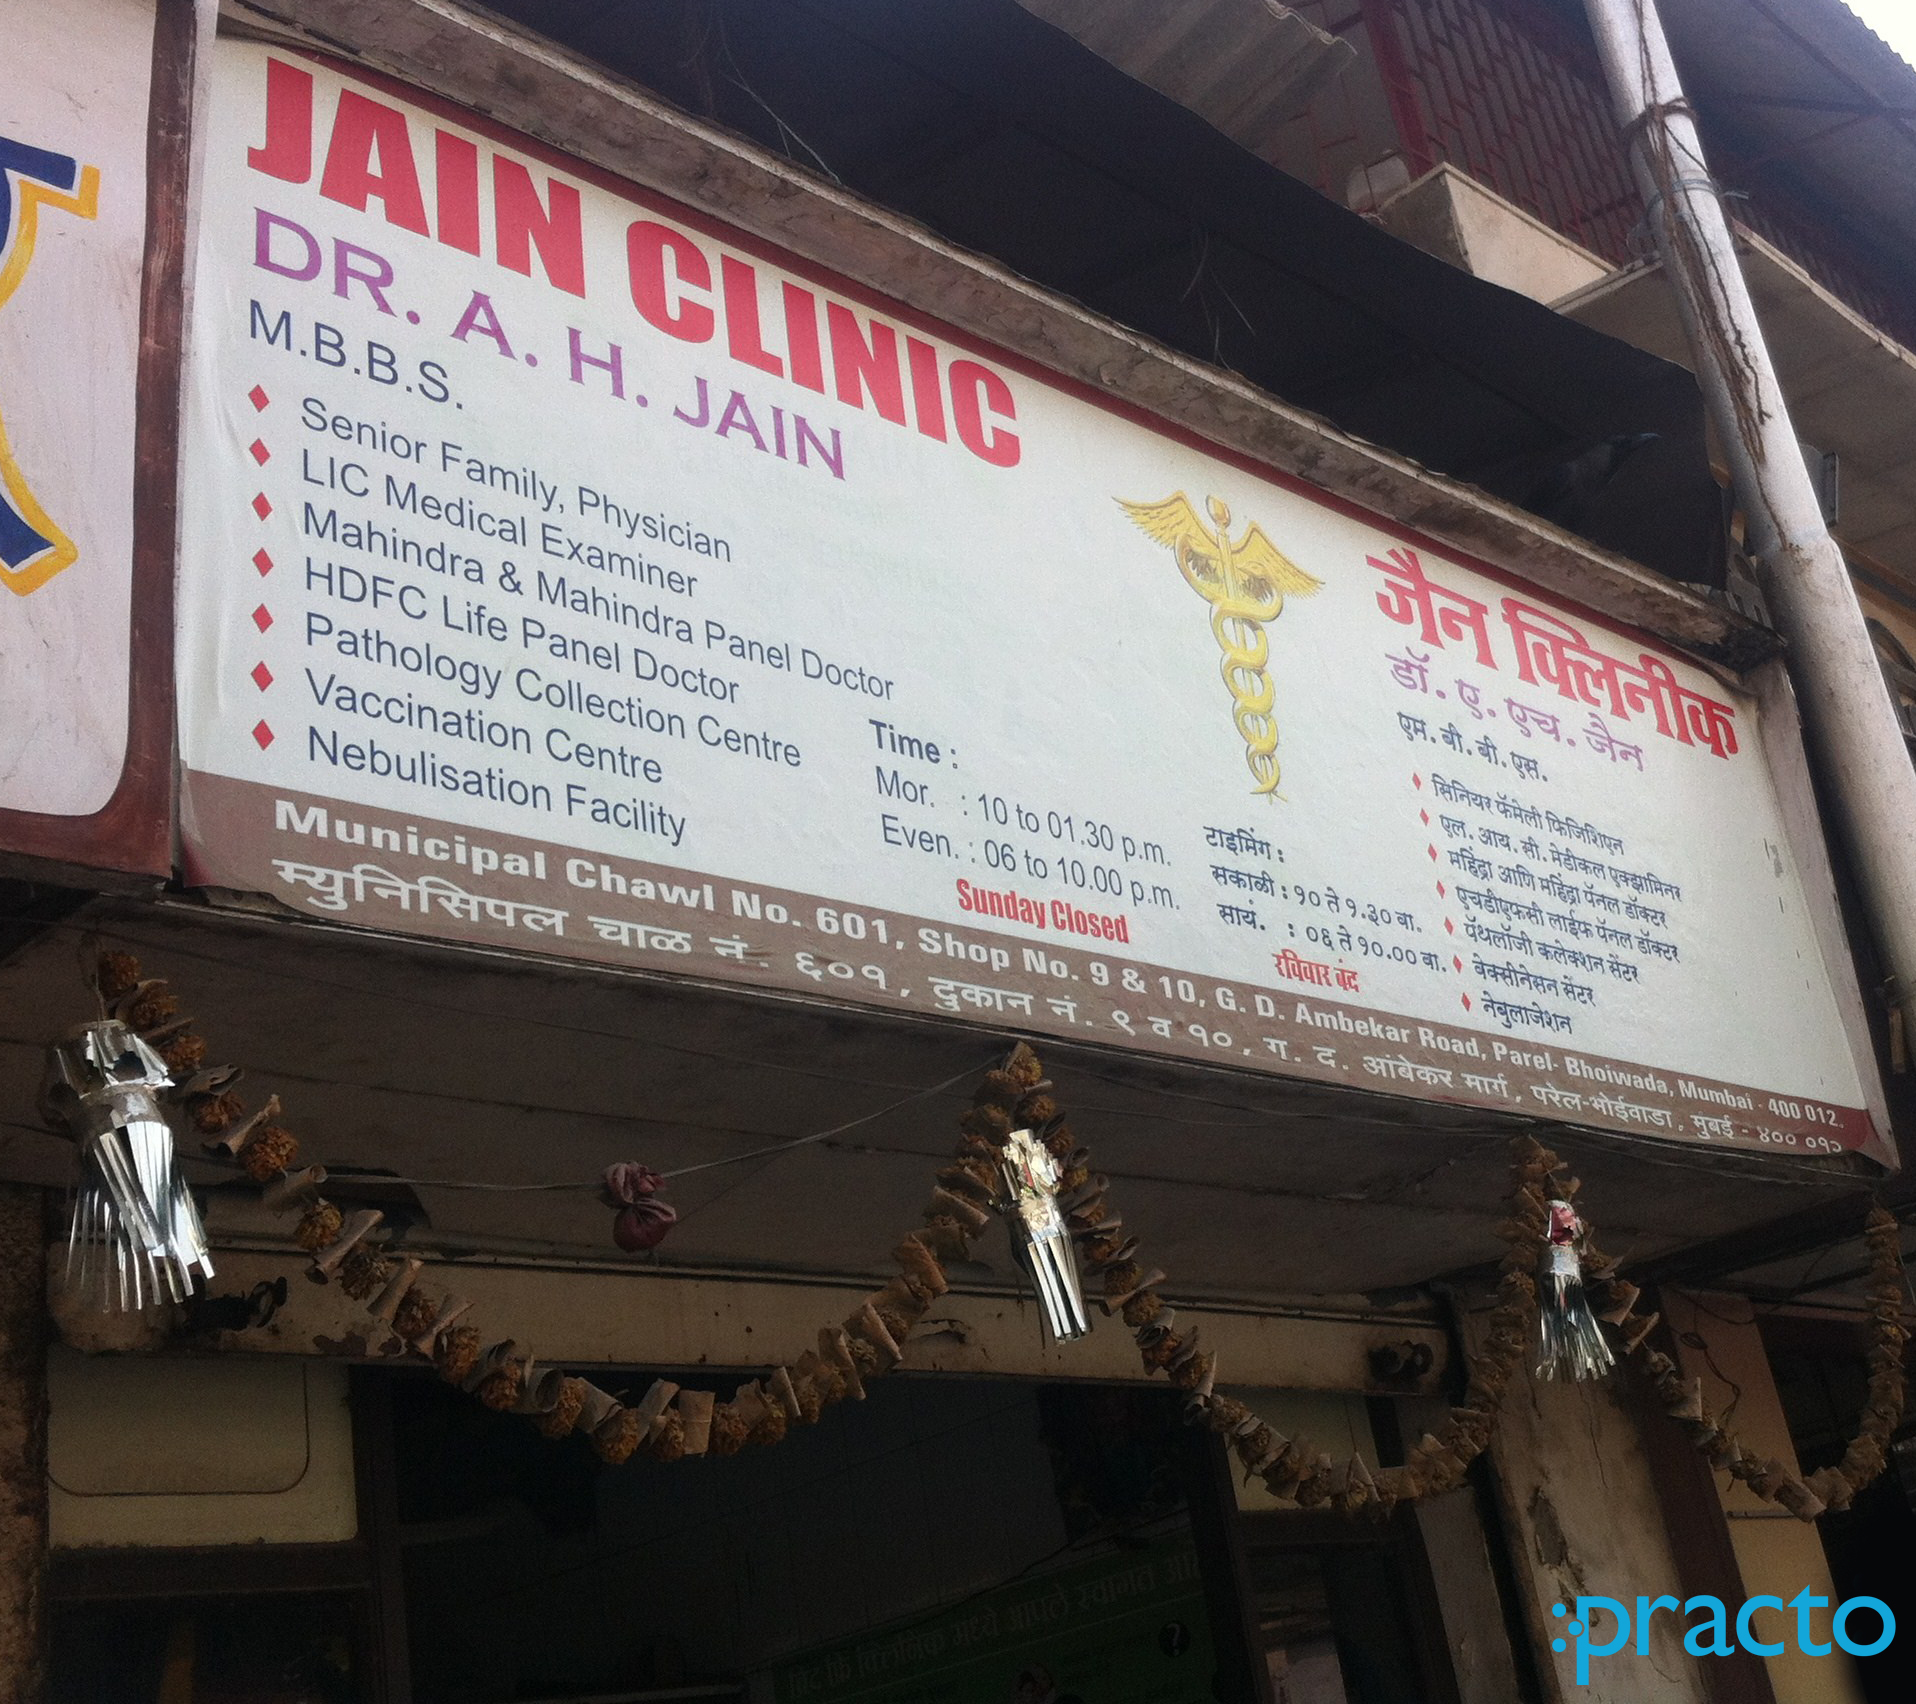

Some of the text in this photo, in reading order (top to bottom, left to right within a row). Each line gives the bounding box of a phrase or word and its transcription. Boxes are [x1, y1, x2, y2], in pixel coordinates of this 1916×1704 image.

[247, 56, 1020, 468] JAIN CLINIC
[249, 298, 462, 410] M.B.B.S.
[253, 206, 846, 481] DR. A. H. JAIN
[301, 397, 731, 563] Senior Family, Physician
[303, 448, 697, 597] LIC Medical Examiner
[304, 501, 894, 700] Mahindra & Mahindra Panel Doctor
[305, 556, 740, 704] HDFC Life Panel Doctor
[1366, 547, 1738, 760] जैन क्लिनीक
[304, 667, 662, 784] Vaccination Centre
[306, 611, 801, 767] Pathology Collection Centre
[868, 718, 941, 764] Time
[1582, 712, 1644, 772] जैन
[309, 725, 686, 847] Nebulisation Facility
[875, 765, 935, 808] Mor.
[978, 793, 1008, 826] 10
[1016, 803, 1040, 834] to
[1047, 811, 1114, 852] 01.30
[1121, 835, 1171, 867] p.m.
[1431, 773, 1494, 815] सिनियर
[881, 813, 959, 859] Even.
[984, 839, 1017, 872] 06
[1024, 849, 1048, 880] to
[1057, 857, 1123, 897] 10.00
[1129, 880, 1180, 910] p.m.
[956, 878, 1130, 944] Sunday Closed
[1209, 864, 1275, 897] सकाळी
[1293, 885, 1321, 907] १०
[1324, 887, 1340, 914] ते
[1497, 863, 1536, 892] आणि
[1582, 881, 1621, 915] पॅनल
[1621, 894, 1668, 930] डॉक्टर
[272, 859, 570, 936] म्युनिसिपल
[587, 916, 692, 953] चाळ
[928, 976, 1034, 1015] दुकान
[1363, 1054, 1453, 1088] आंबेकर
[275, 800, 546, 879] Municipal
[566, 858, 714, 911] Chawl
[732, 890, 801, 926] No.
[816, 907, 904, 950] 601,
[918, 928, 1010, 972] Shop
[1022, 948, 1078, 981] No.
[1089, 962, 1109, 986] 9
[1122, 968, 1147, 994] &
[1159, 976, 1205, 1007] 10,
[1215, 987, 1246, 1013] G.
[1255, 994, 1285, 1020] D.
[1296, 1003, 1410, 1043] Ambekar
[1417, 1026, 1486, 1060] Road,
[1564, 1056, 1673, 1097] Bhoiwada,
[1677, 1079, 1753, 1110] Mumbai
[1768, 1098, 1801, 1119] 400
[1271, 948, 1333, 987] रविवार
[1305, 926, 1335, 951] ०६
[1336, 924, 1352, 952] ते
[1455, 885, 1681, 964] एचडीएफसी लाईफ पॅनल डॉक्टर
[1606, 953, 1640, 984] सेंटर
